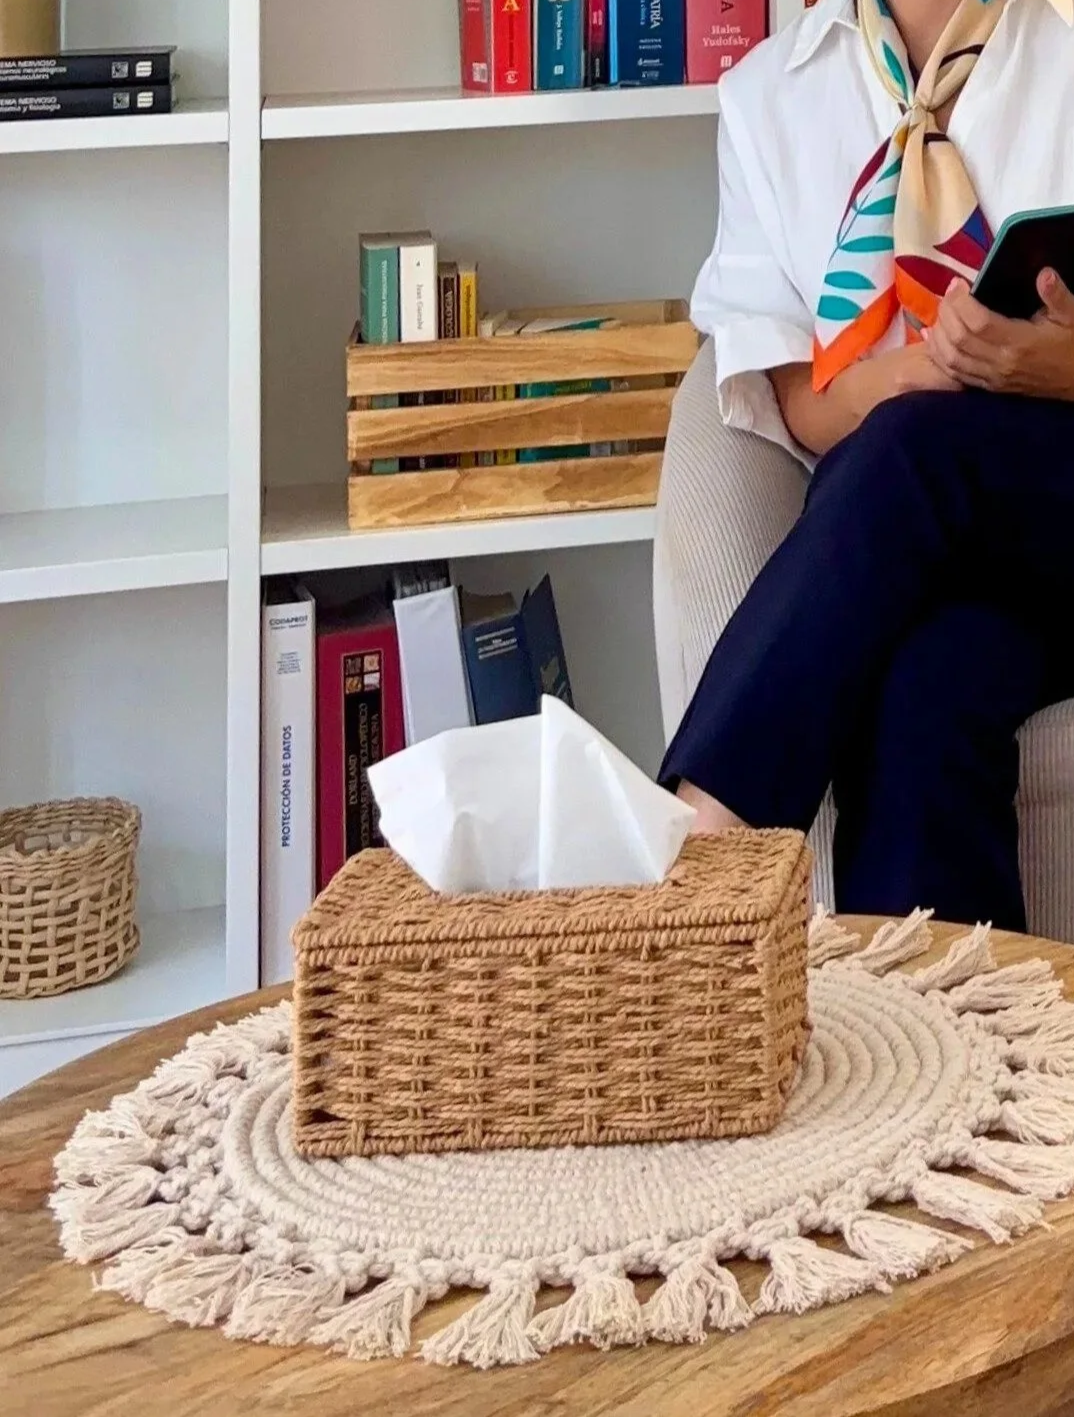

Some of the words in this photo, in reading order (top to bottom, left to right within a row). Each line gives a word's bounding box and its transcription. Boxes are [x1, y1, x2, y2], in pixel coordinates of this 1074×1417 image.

[711, 24, 741, 35] Hales
[703, 35, 750, 47] Yudofsky
[18, 59, 56, 68] NERVIOSO
[18, 96, 57, 105] NERVIOSO
[29, 104, 61, 112] fisiología
[283, 725, 292, 760] DATOS
[283, 763, 291, 776] DE
[349, 754, 358, 805] DORLAND
[281, 779, 292, 847] PROTECCIÓN
